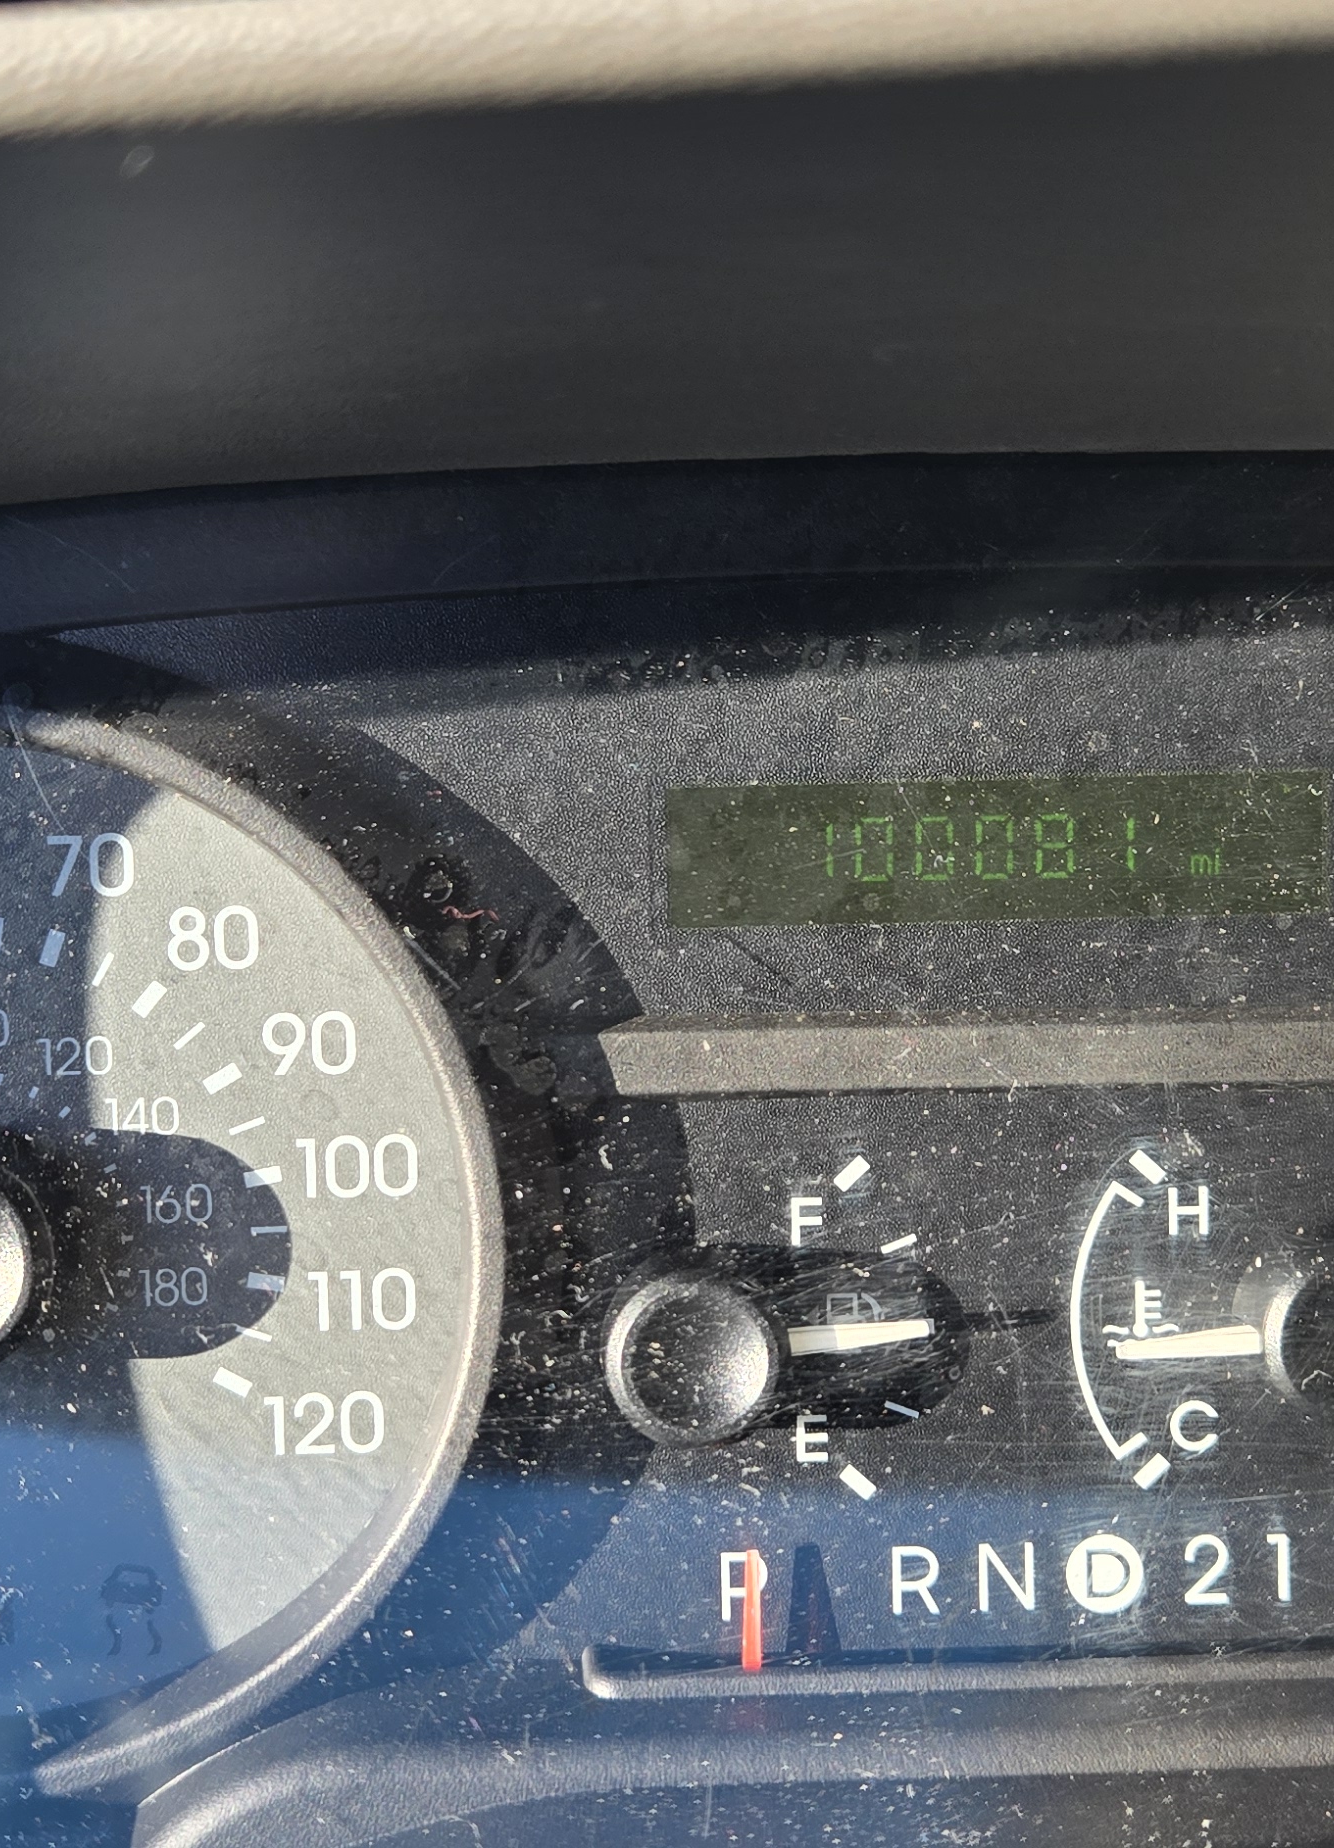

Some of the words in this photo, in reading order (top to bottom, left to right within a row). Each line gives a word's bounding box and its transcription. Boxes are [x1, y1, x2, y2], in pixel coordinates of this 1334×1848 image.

[47, 832, 134, 897] 70
[826, 814, 1135, 882] 100081
[1190, 847, 1222, 877] mi
[168, 905, 259, 971] 80
[38, 1035, 113, 1077] 120
[261, 1010, 356, 1075] 90
[104, 1096, 180, 1136] 140
[295, 1133, 418, 1199] 100
[139, 1184, 214, 1224] 160
[790, 1197, 823, 1246] F
[1168, 1185, 1210, 1236] H
[139, 1267, 208, 1307] 180
[307, 1267, 416, 1331] 110
[264, 1390, 385, 1456] 120
[795, 1414, 829, 1462] E
[1169, 1400, 1219, 1452] C
[720, 1551, 768, 1621] P
[891, 1546, 940, 1615] R
[978, 1543, 1035, 1612] N
[1184, 1533, 1230, 1605] 2
[1266, 1533, 1292, 1601] 1
